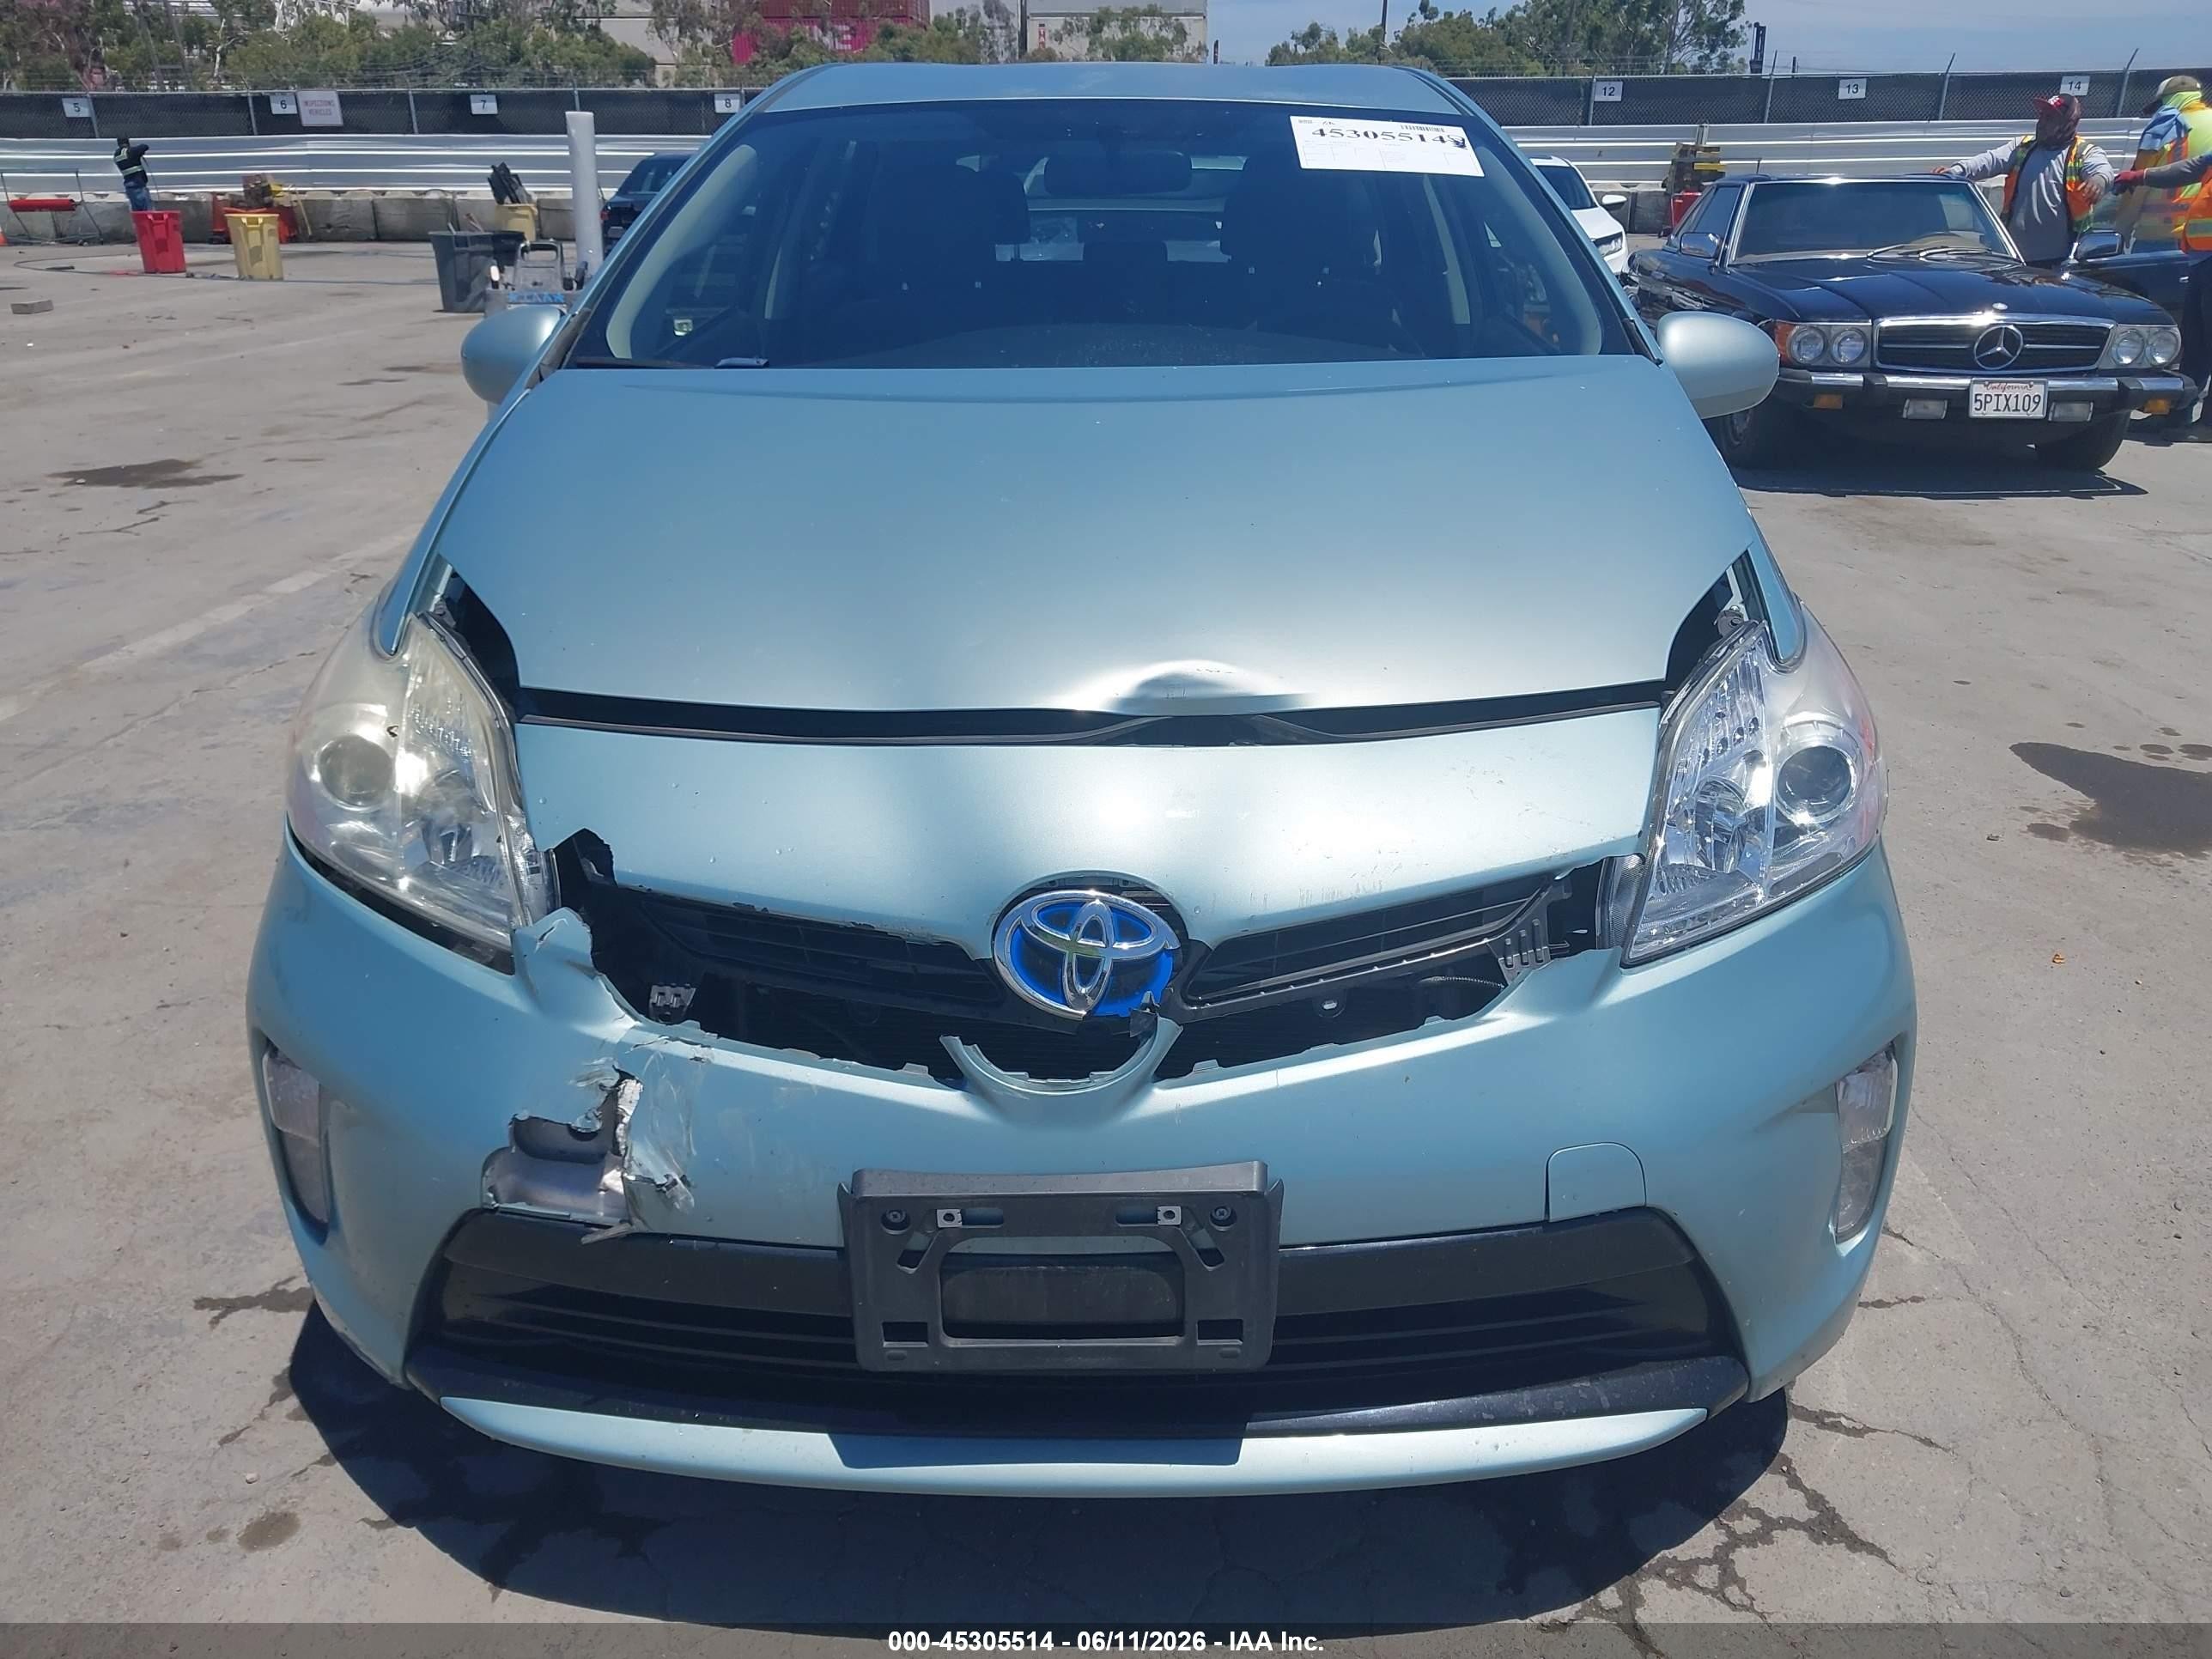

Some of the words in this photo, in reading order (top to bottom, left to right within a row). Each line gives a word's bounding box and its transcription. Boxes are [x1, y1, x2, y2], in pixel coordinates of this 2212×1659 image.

[1846, 83, 1859, 94] 13
[2068, 81, 2081, 91] 14
[1602, 86, 1615, 97] 12
[73, 102, 81, 112] 5
[280, 100, 287, 109] 6
[480, 100, 487, 110] 7
[725, 98, 732, 108] 8
[1985, 382, 2030, 392] California
[1973, 393, 2041, 412] 5PIX109
